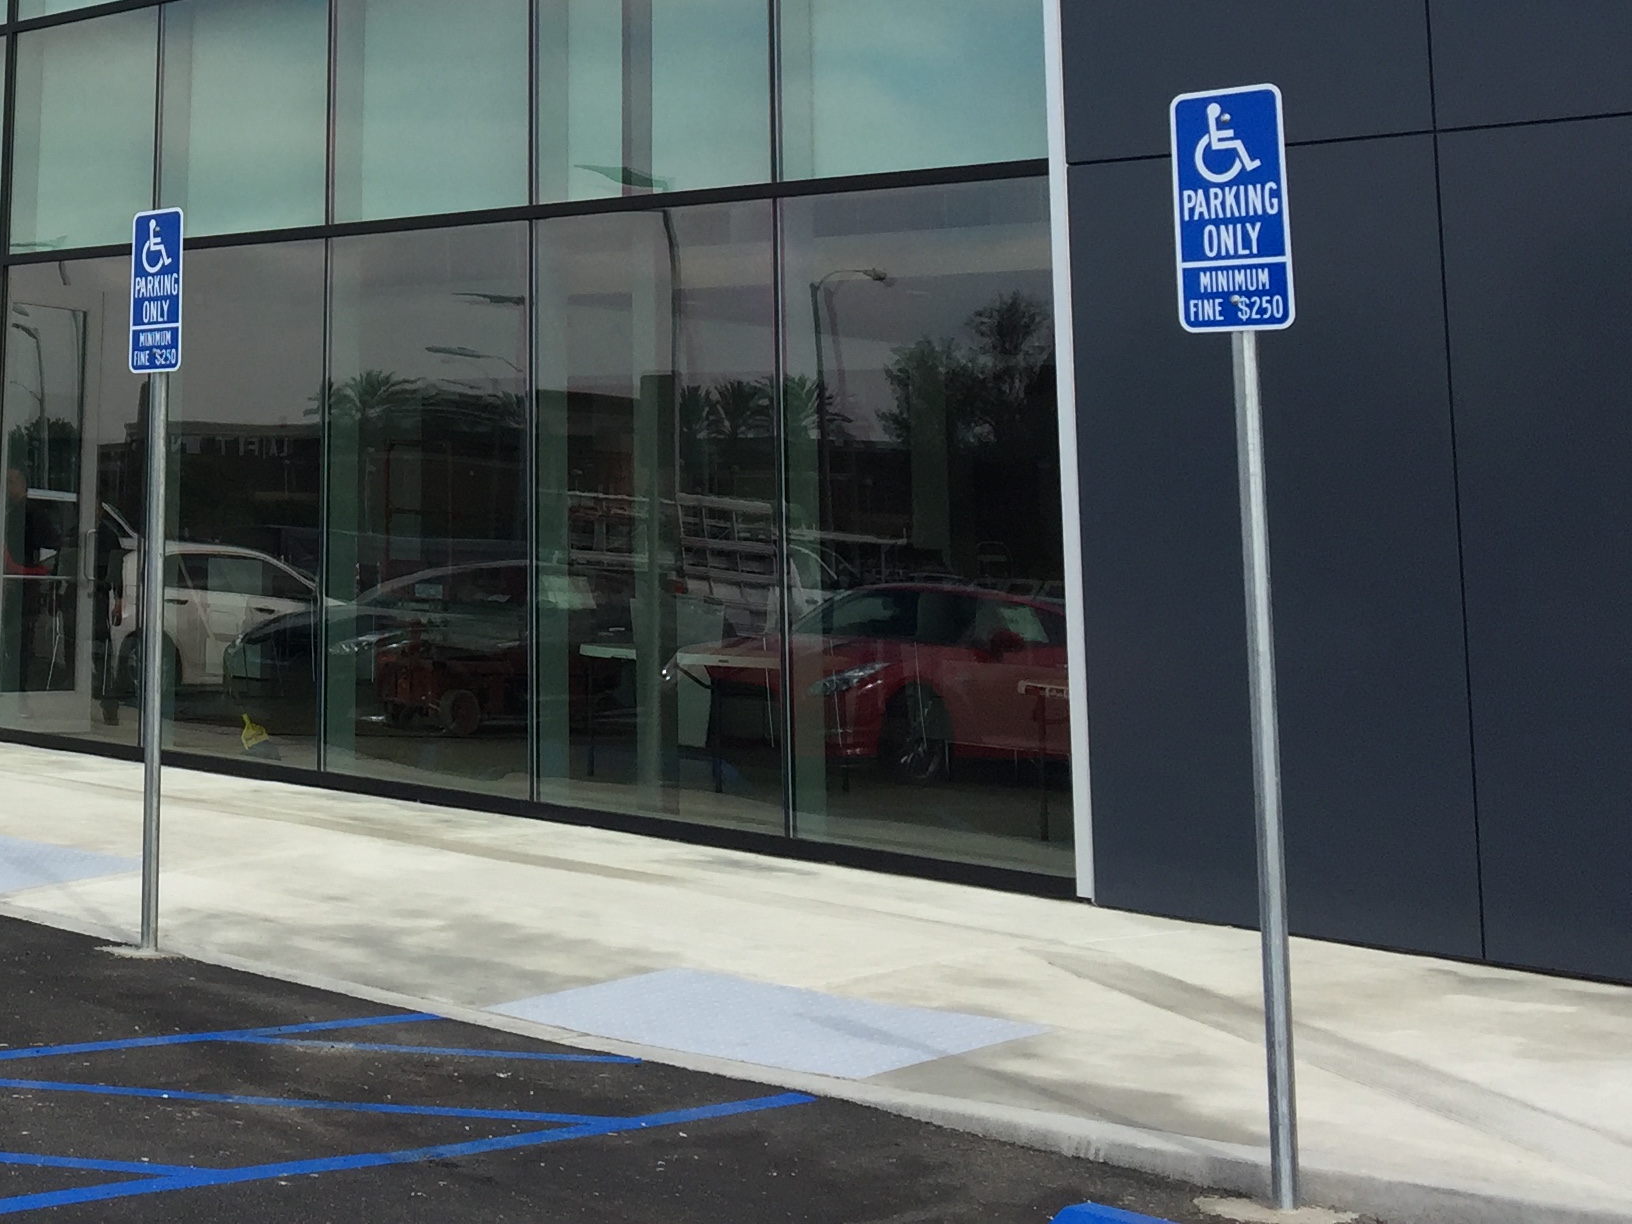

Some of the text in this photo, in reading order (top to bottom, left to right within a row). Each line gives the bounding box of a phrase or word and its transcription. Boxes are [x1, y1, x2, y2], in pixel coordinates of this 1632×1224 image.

[1183, 182, 1279, 221] PARKING
[1203, 222, 1261, 258] ONLY
[135, 273, 178, 298] PARKING
[1199, 267, 1269, 293] MINIMUM
[142, 299, 170, 323] ONLY
[1190, 295, 1283, 322] FINE $250
[139, 330, 172, 347] MINIMUM
[134, 349, 177, 366] FINE $250
